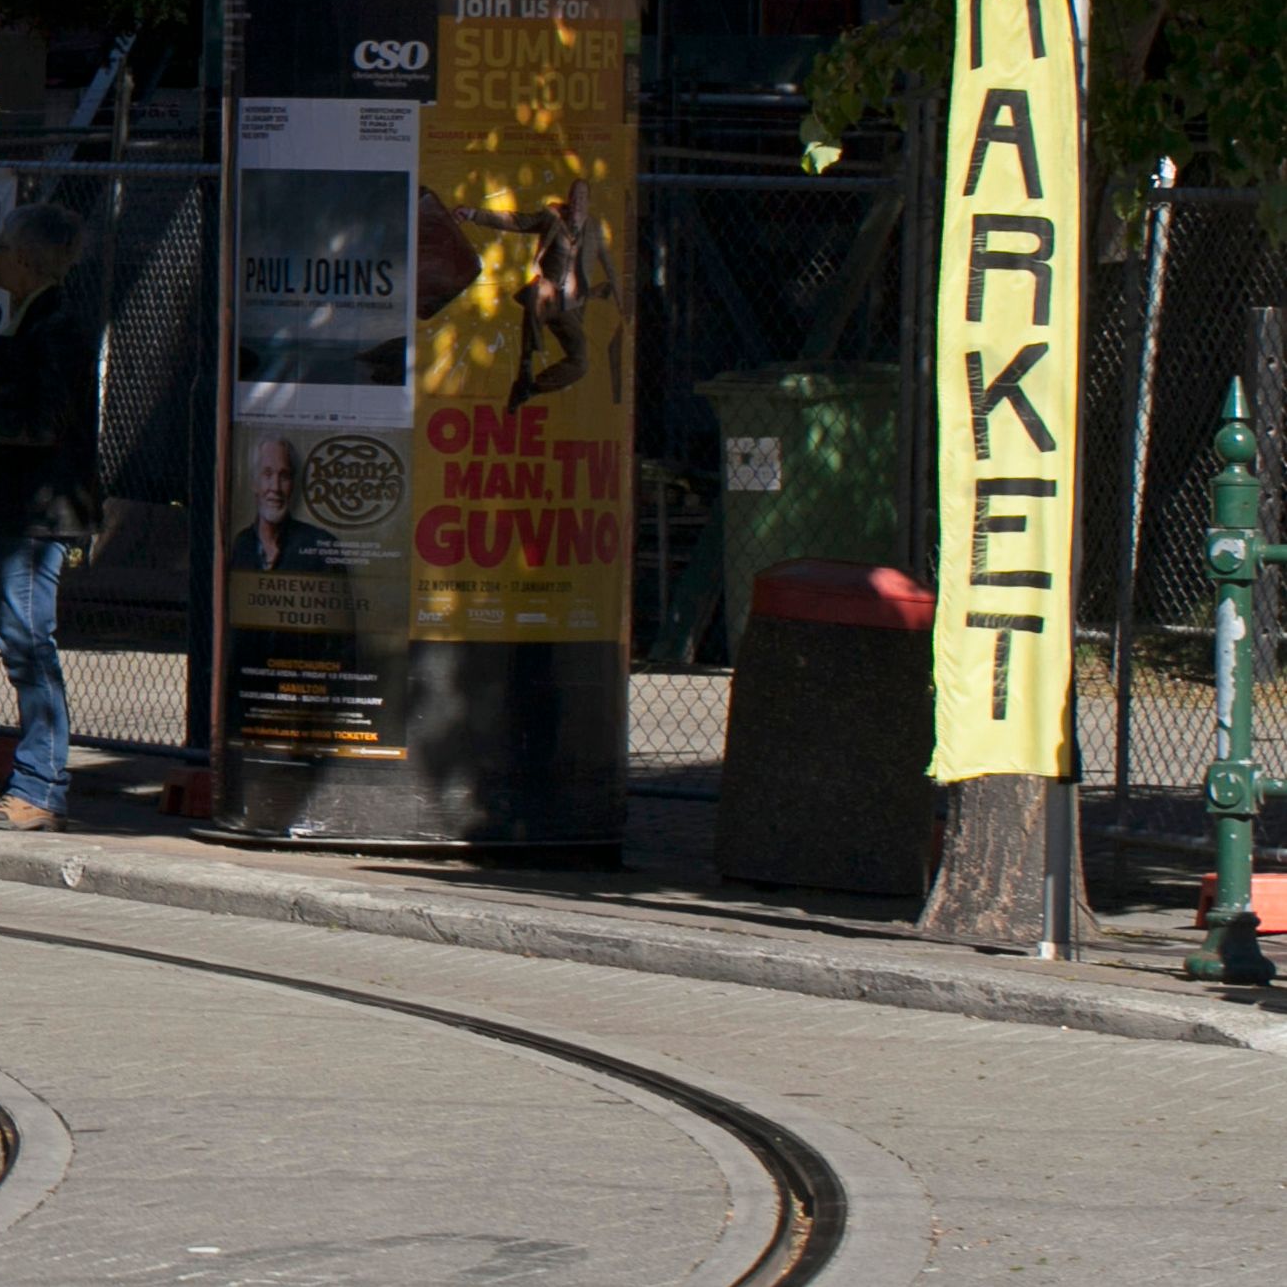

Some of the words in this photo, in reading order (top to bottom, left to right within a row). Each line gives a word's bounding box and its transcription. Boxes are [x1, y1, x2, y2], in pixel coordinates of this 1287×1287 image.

[455, 28, 619, 69] SUMMER
[455, 71, 608, 110] SCHOOL
[245, 257, 295, 294] PAUL
[303, 258, 394, 296] JOHNS
[427, 404, 549, 457] ONE
[311, 455, 397, 485] Kenny
[444, 461, 554, 504] MAN,
[308, 478, 403, 518] Rogers
[300, 596, 370, 612] UNDER
[418, 580, 429, 592] 22
[432, 580, 476, 593] NOVEMBER
[277, 610, 327, 625] TOUR
[333, 731, 379, 742] TICKETEK
